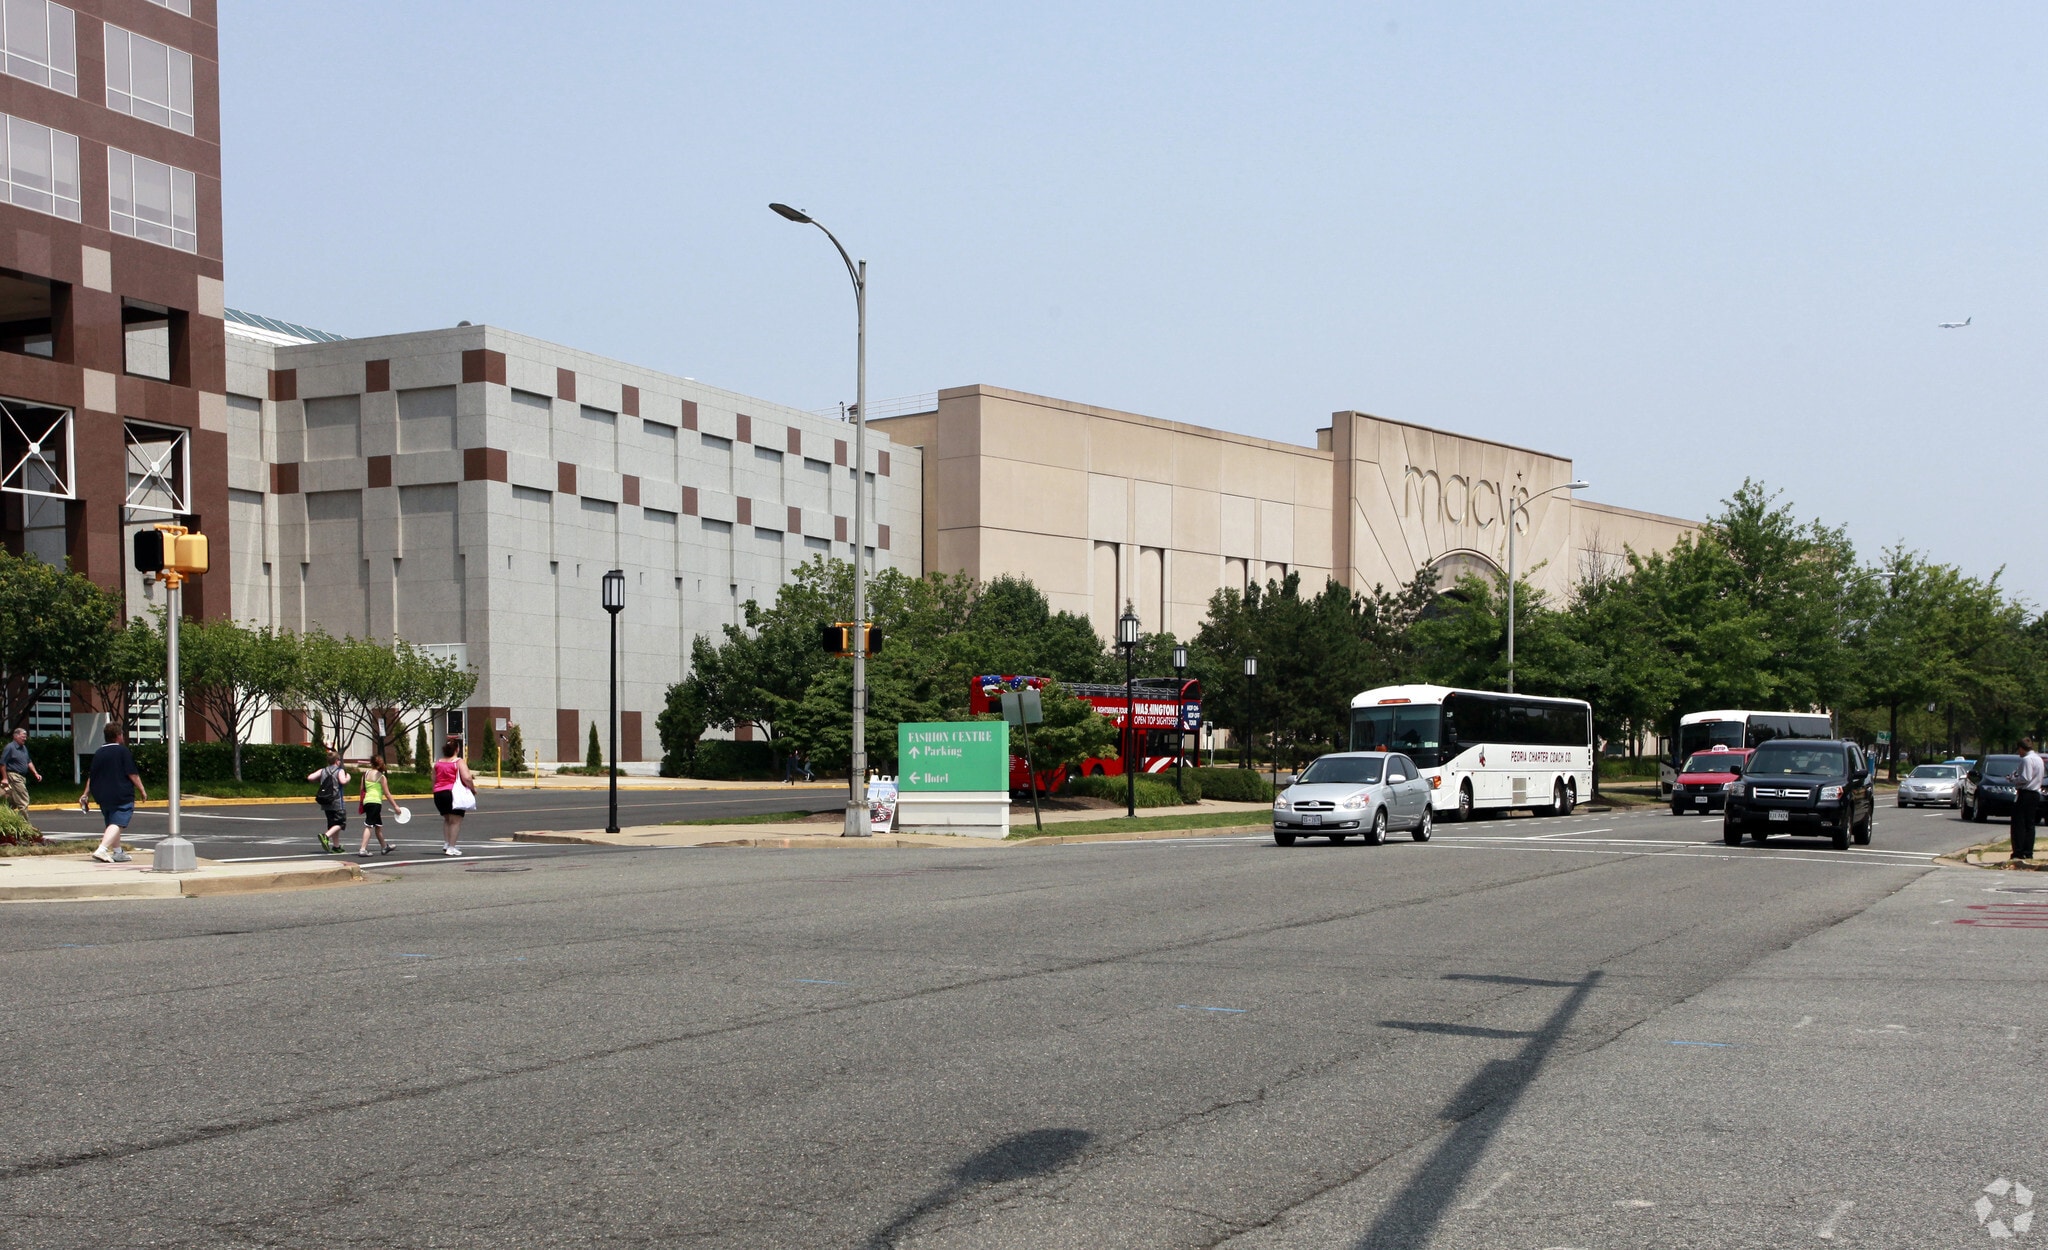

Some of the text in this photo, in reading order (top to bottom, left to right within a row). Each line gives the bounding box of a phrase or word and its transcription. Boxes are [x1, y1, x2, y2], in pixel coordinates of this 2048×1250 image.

[1133, 716, 1146, 725] OPEN
[1147, 716, 1156, 725] TOP
[908, 730, 992, 743] FASHION CENTRE
[924, 745, 962, 759] Parking
[1511, 751, 1526, 762] PEORIA
[1529, 751, 1548, 762] CHARTER
[1550, 751, 1564, 762] COACH
[924, 772, 949, 783] Hotel
